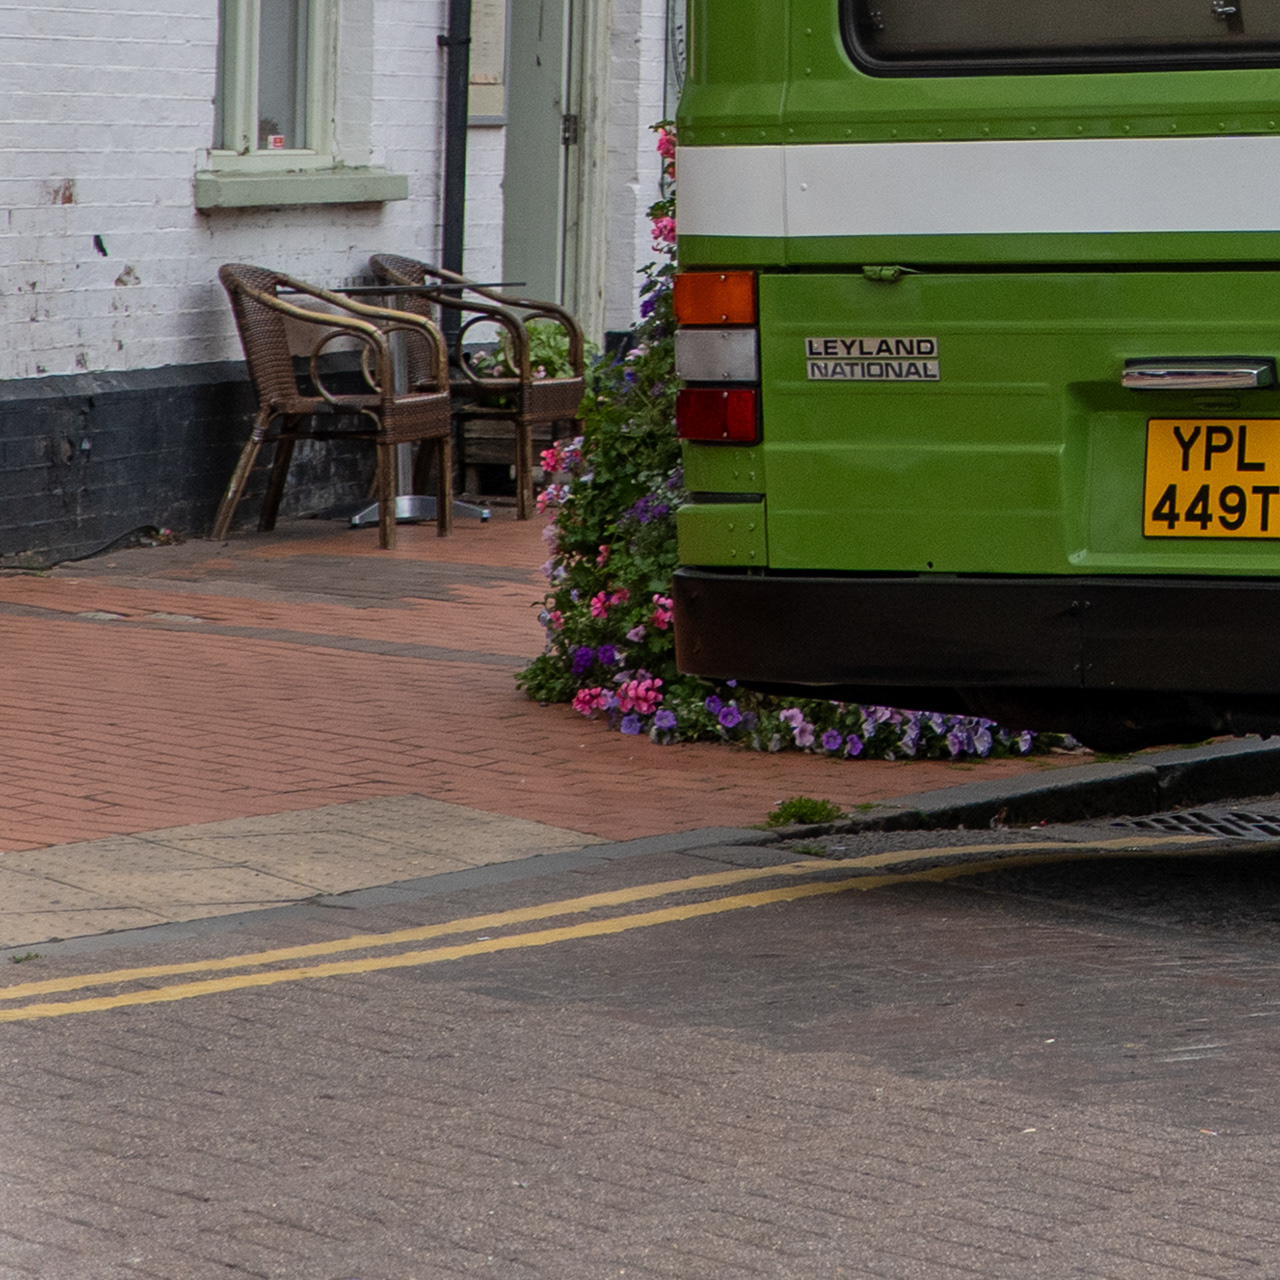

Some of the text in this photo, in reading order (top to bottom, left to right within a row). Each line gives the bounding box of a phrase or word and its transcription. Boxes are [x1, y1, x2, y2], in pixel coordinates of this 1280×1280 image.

[807, 338, 935, 356] LEYLAND
[810, 361, 938, 379] NATIONAL
[1172, 425, 1266, 472] YPL
[1152, 483, 1280, 532] 449T
